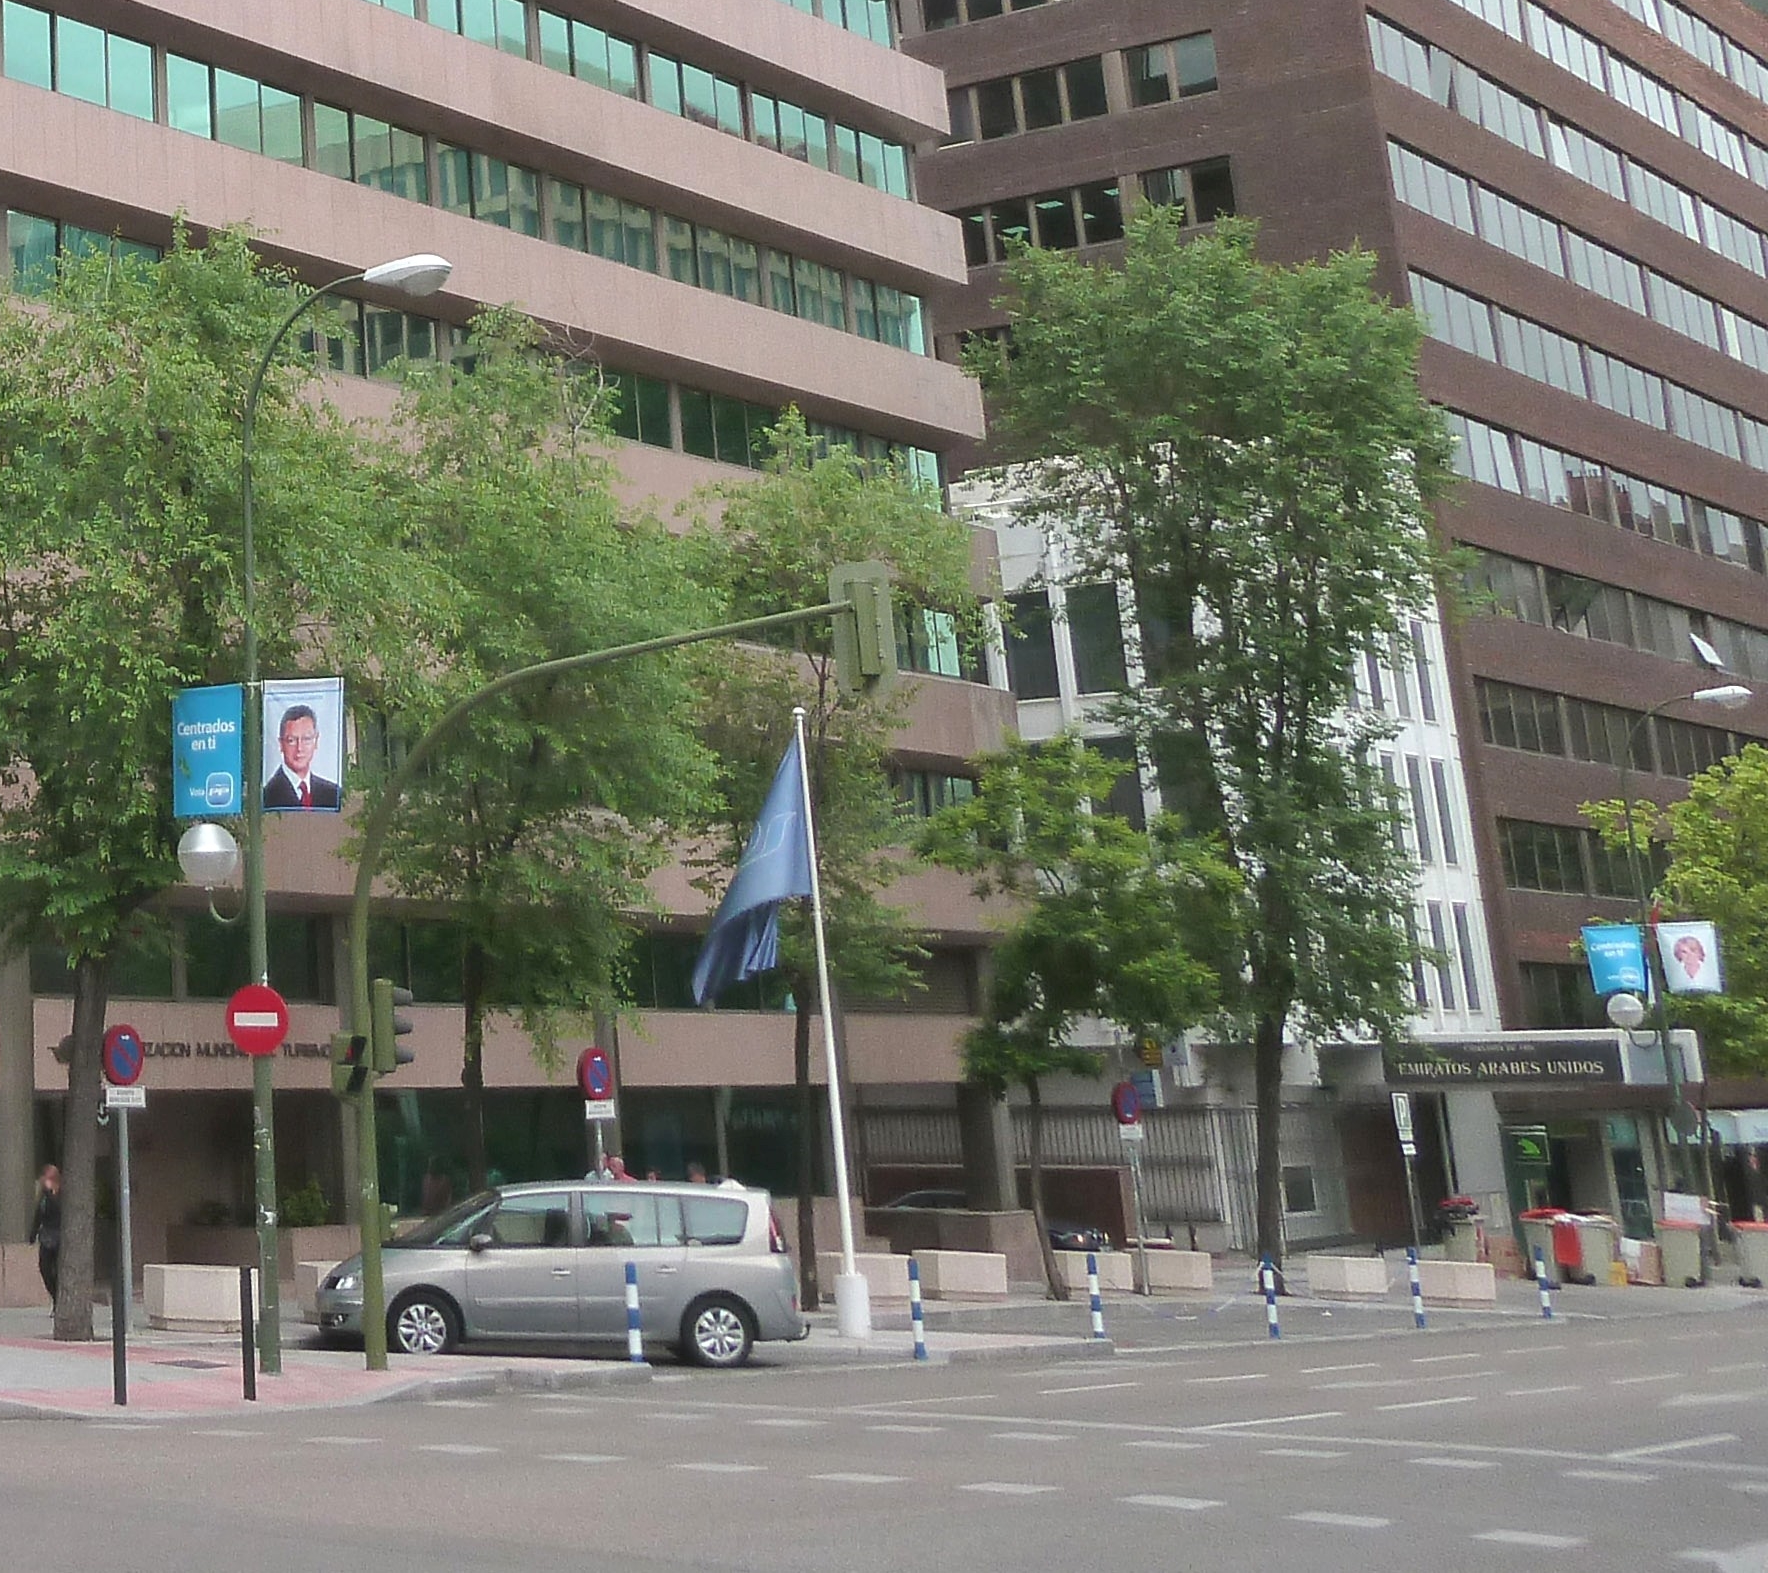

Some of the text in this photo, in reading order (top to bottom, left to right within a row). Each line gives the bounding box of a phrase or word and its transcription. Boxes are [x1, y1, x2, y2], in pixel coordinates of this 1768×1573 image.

[177, 718, 235, 736] Centrados
[191, 735, 216, 751] en ti
[1398, 1060, 1605, 1077] EMIRATOS ARABES UNIDOS
